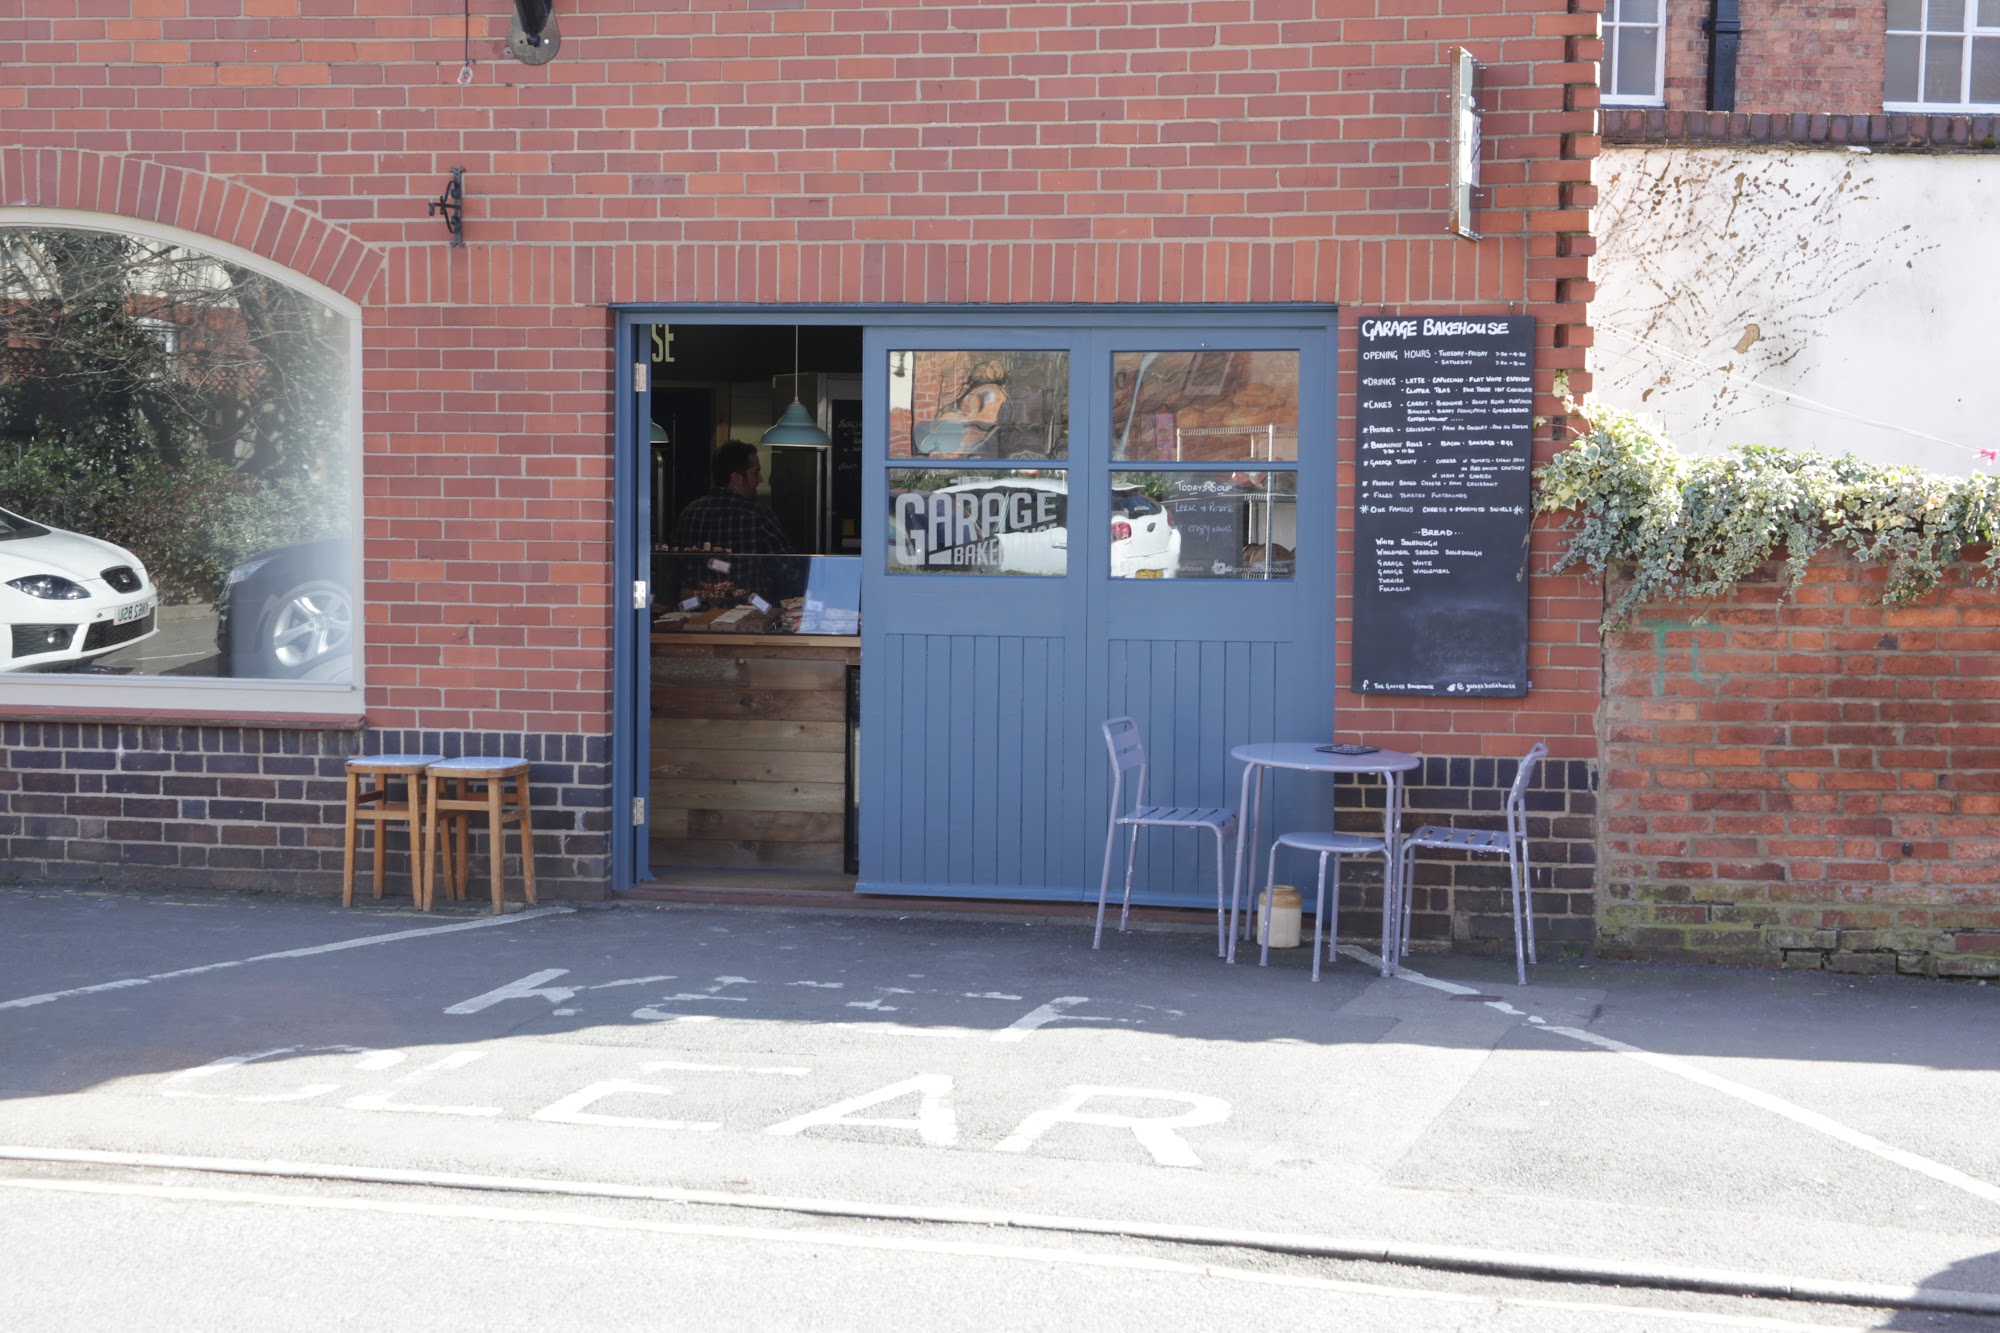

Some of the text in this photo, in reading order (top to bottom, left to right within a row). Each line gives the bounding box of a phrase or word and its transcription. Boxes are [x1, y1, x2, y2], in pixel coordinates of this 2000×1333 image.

[1362, 319, 1509, 341] GARAGE BAKEHOUSE
[1363, 351, 1398, 360] OPENING
[1404, 350, 1431, 358] HOURS
[1368, 378, 1395, 386] DRINKS
[1369, 400, 1392, 409] CAKES
[1175, 502, 1196, 513] LEEK
[895, 492, 1057, 565] GARAGE
[1421, 528, 1453, 536] BREAD
[1376, 538, 1394, 546] WHITE
[160, 1044, 1232, 1168] CLEAR
